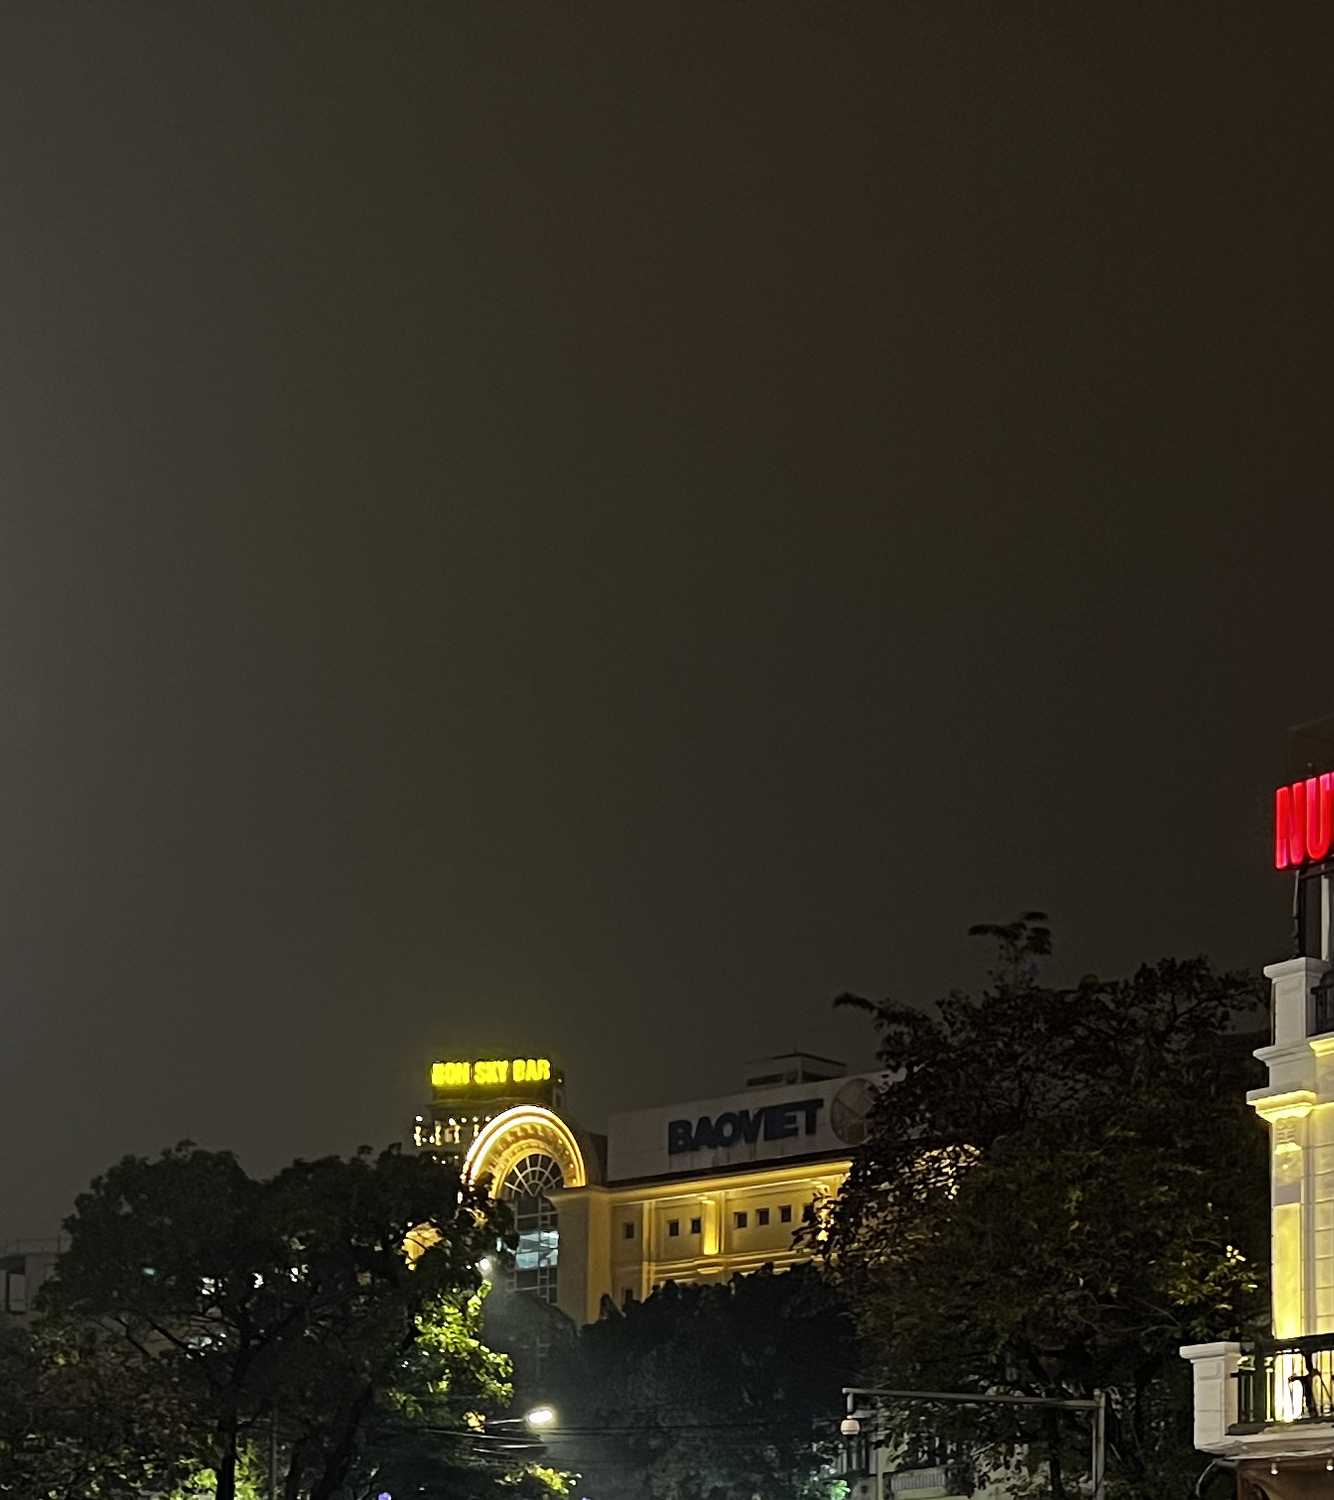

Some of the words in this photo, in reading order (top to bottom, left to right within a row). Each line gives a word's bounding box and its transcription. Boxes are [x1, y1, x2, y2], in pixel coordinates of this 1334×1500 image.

[473, 1059, 509, 1085] SKY
[512, 1058, 551, 1083] BAR
[667, 1098, 824, 1156] BAOVIET
